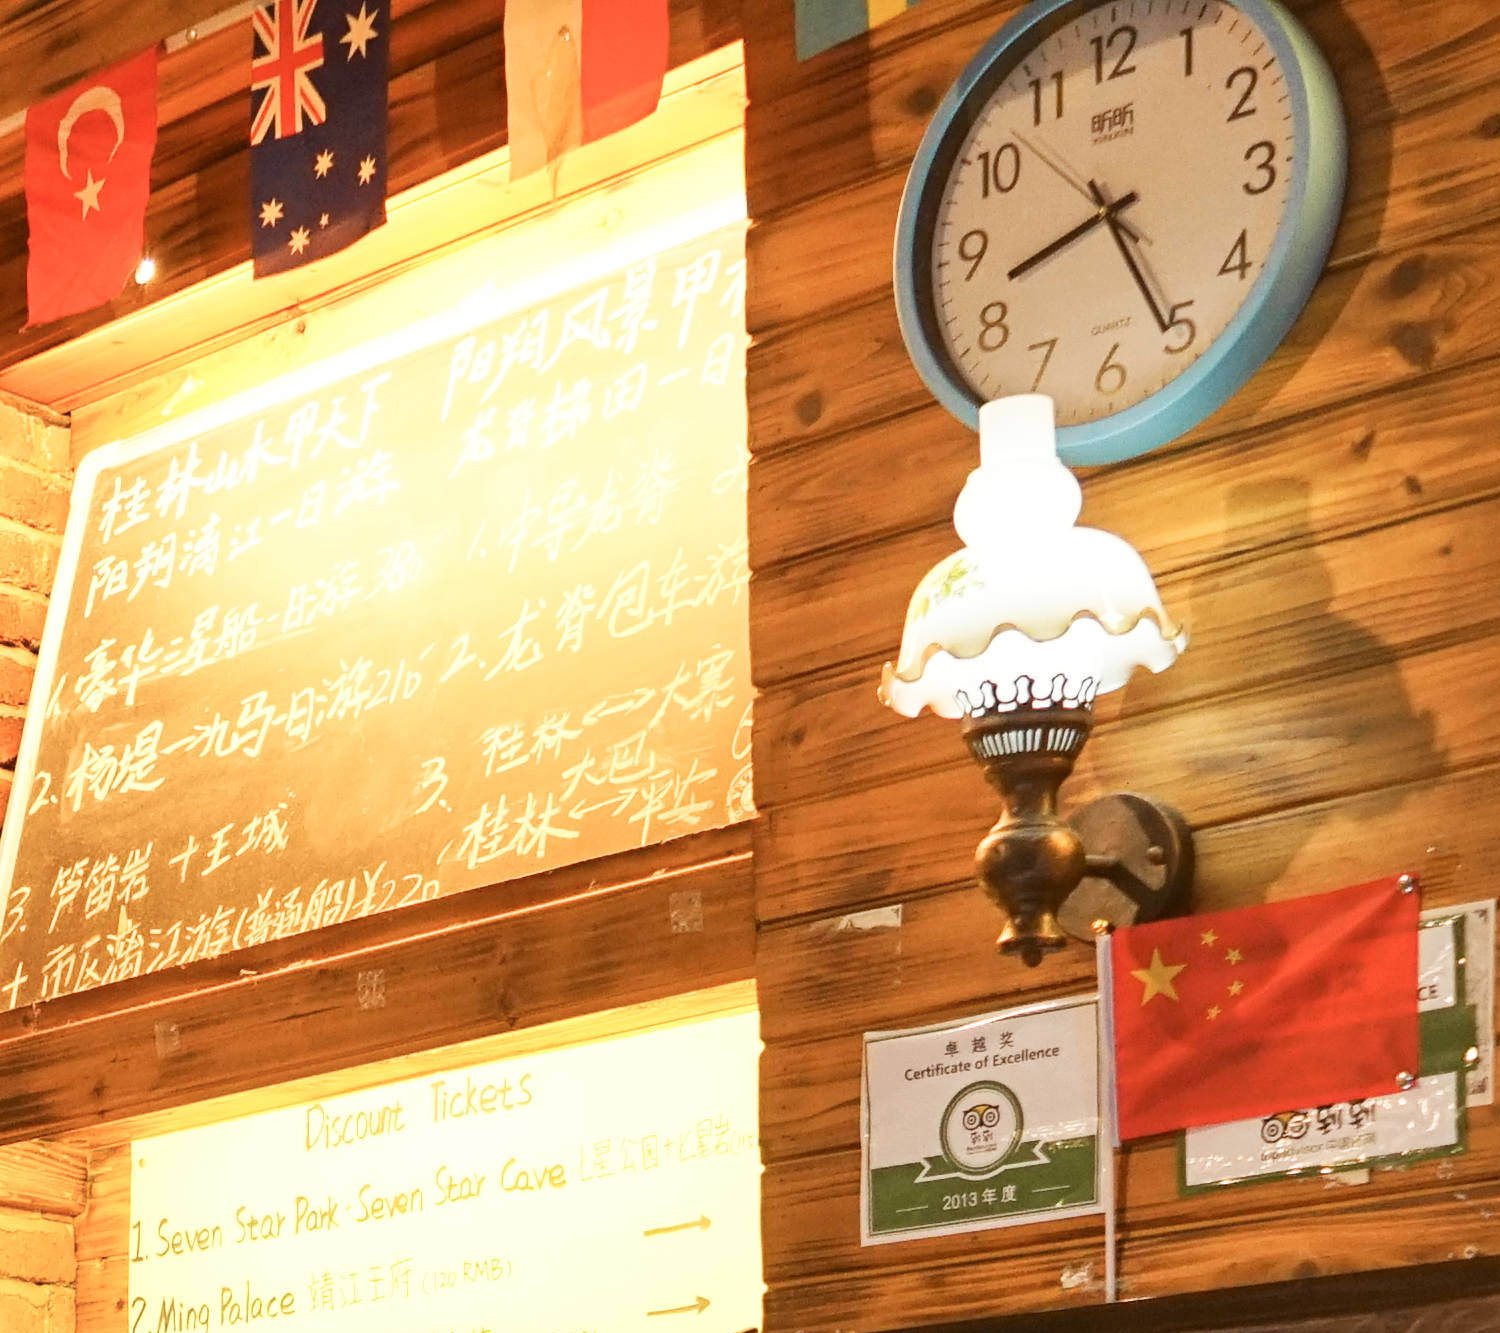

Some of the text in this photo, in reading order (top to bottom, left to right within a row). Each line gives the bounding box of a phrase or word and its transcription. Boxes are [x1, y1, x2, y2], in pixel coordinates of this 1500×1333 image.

[1091, 25, 1138, 85] 12
[1179, 26, 1194, 77] 1
[1030, 71, 1063, 126] 11
[1226, 66, 1257, 123] 2
[978, 142, 1021, 199] 10
[1243, 140, 1278, 196] 3
[958, 229, 988, 281] 9
[1217, 228, 1252, 281] 4
[979, 301, 1008, 353] 8
[1164, 301, 1196, 354] 5
[1027, 337, 1058, 393] 7
[1095, 343, 1126, 395] 6
[905, 1047, 1060, 1081] Certificate of Excellence
[944, 1031, 1014, 1056] 卓越奖
[306, 1073, 533, 1151] Discount Tickets
[235, 1206, 286, 1243] Star
[435, 1165, 486, 1204] Star
[499, 1157, 567, 1191] Cave
[219, 1280, 295, 1325] Palace
